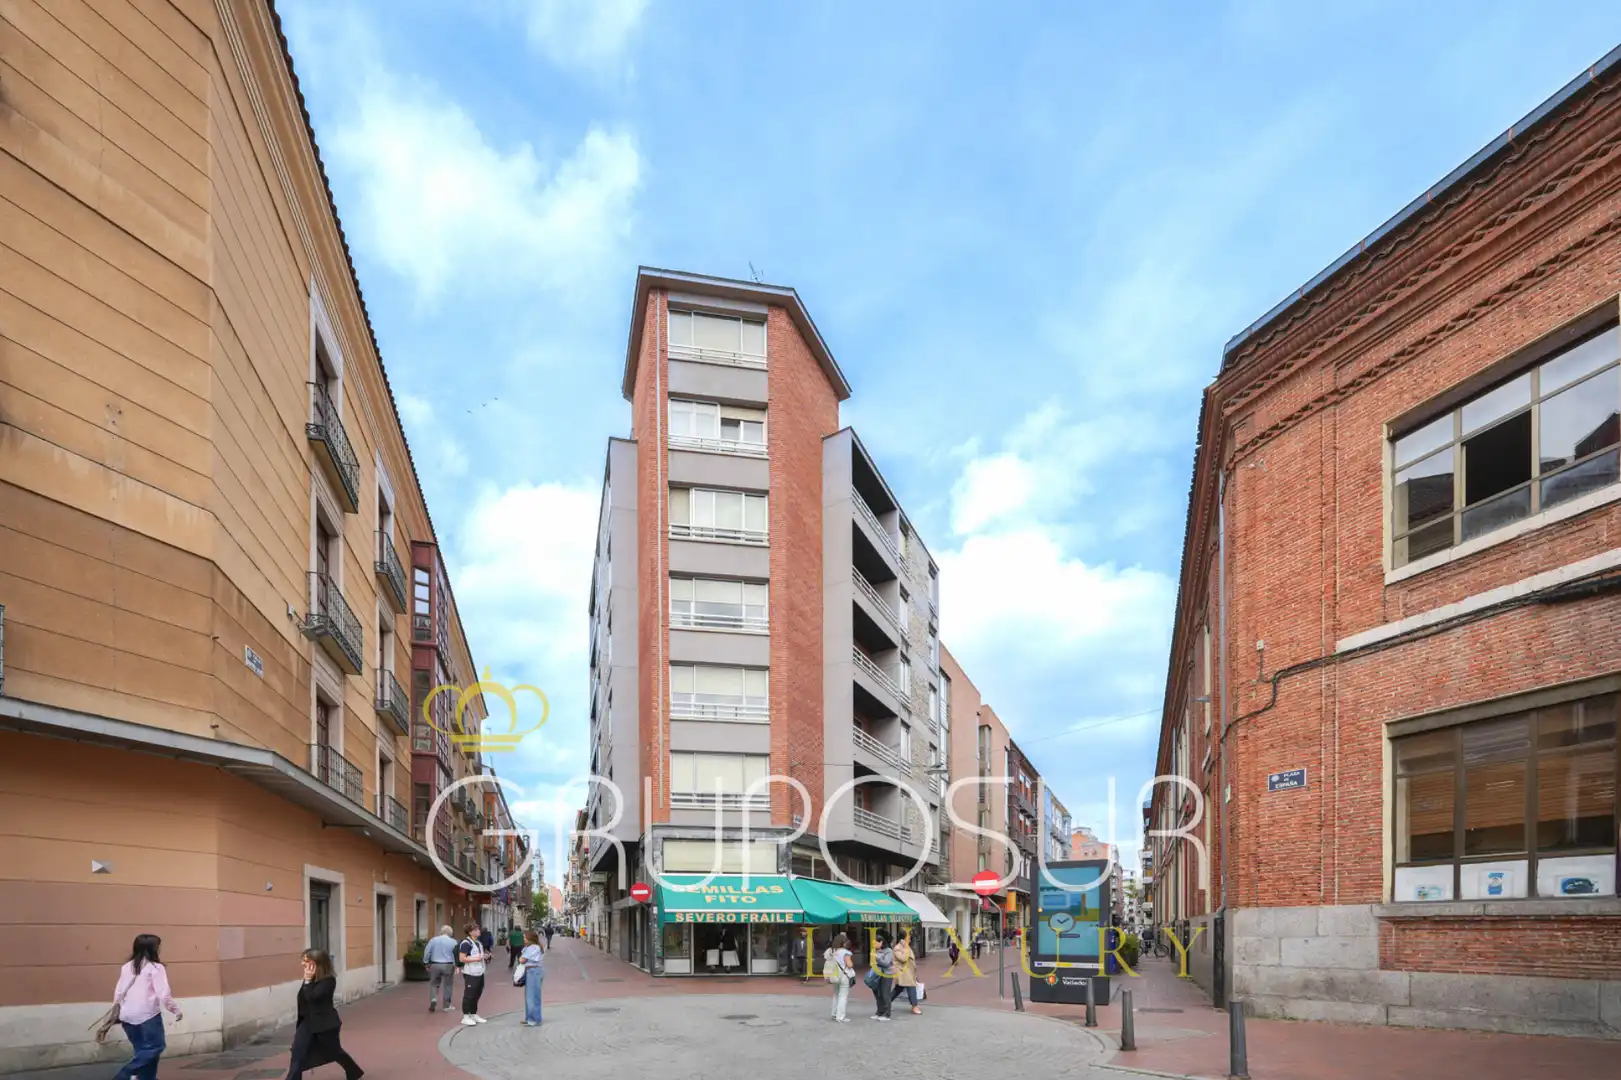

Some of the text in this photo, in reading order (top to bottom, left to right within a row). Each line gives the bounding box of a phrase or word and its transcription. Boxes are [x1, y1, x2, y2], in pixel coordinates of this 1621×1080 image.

[671, 885, 784, 894] SEMILLAS
[704, 895, 757, 904] FITO
[675, 911, 794, 923] SEVERO FRAILE
